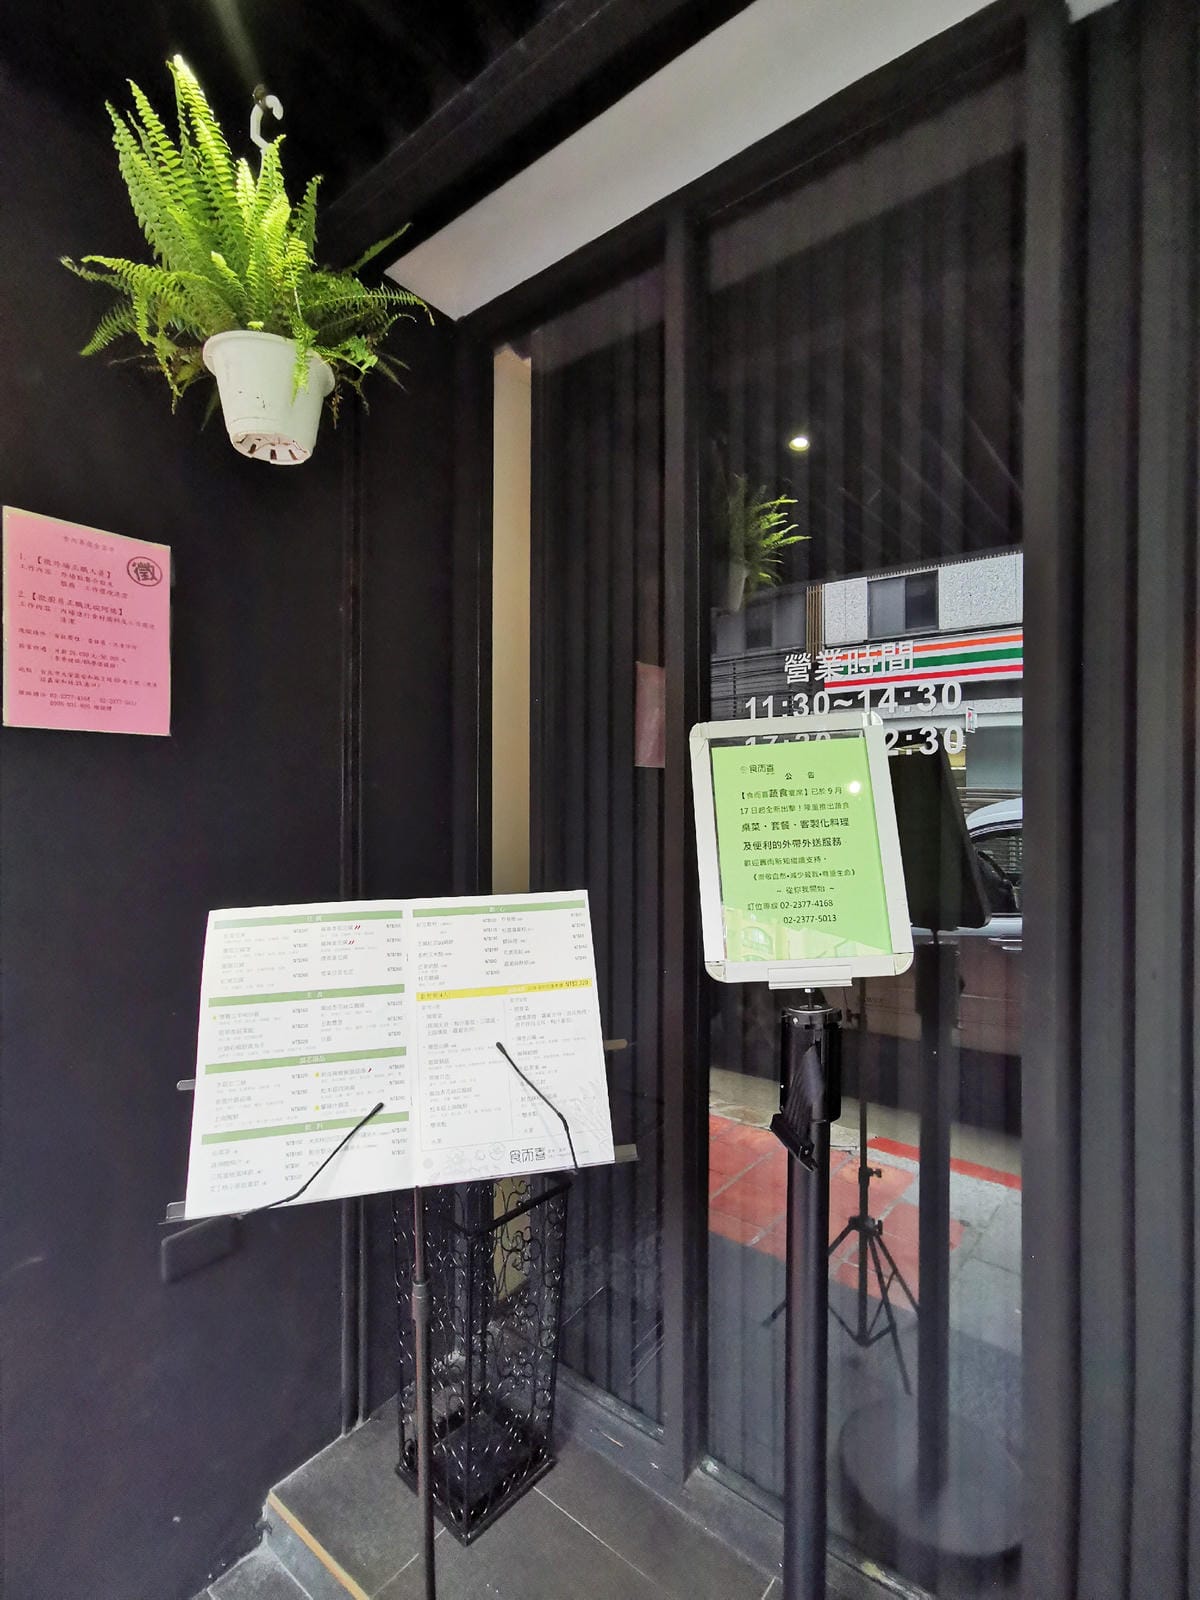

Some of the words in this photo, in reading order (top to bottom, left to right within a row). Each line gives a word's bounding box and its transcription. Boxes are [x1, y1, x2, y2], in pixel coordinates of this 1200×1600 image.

[131, 561, 158, 582] 徵
[784, 640, 914, 685] 營業時間
[745, 680, 963, 721] 11:30~14:30
[743, 837, 842, 851] 及便利的外帶外送服務
[779, 899, 834, 909] 02-2377-4168
[783, 914, 837, 924] 02-2377-5013
